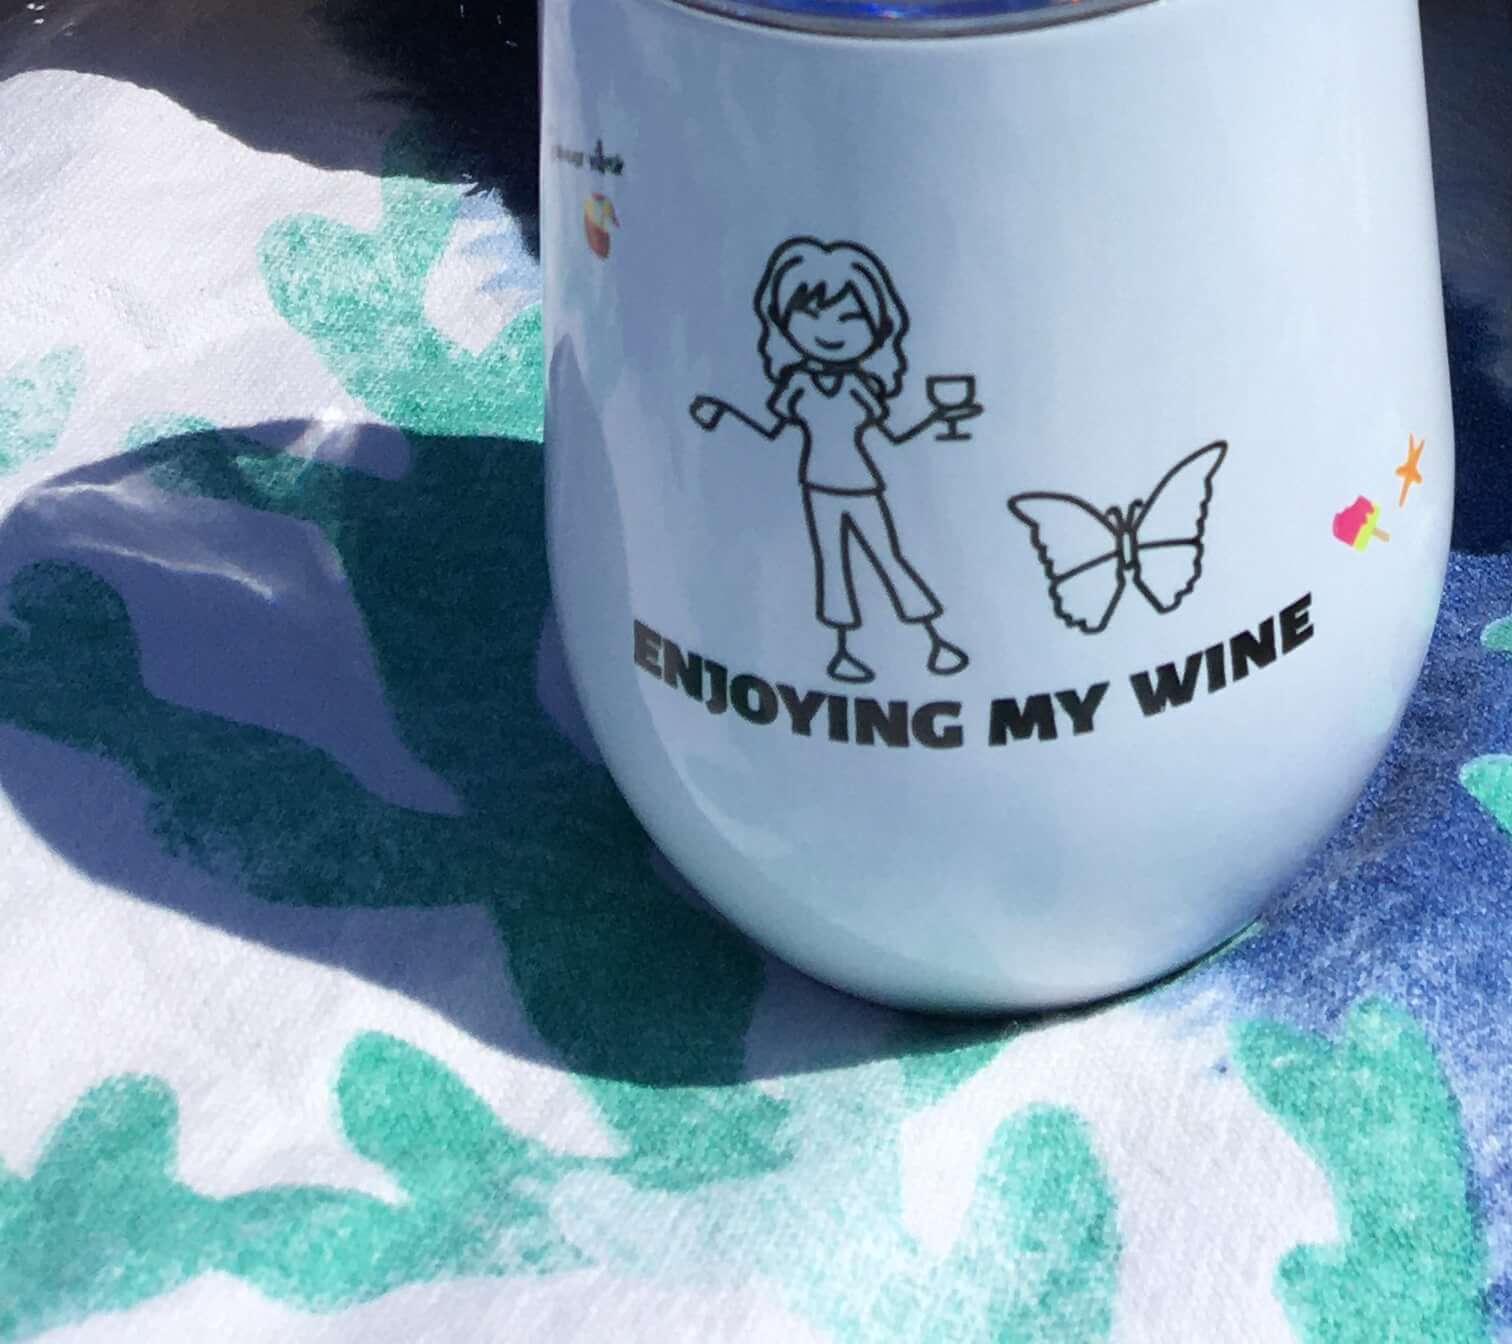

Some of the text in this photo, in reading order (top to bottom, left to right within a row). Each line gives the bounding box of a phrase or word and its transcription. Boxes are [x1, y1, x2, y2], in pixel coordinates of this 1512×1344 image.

[632, 593, 1315, 749] ENJOYING MY WINE
